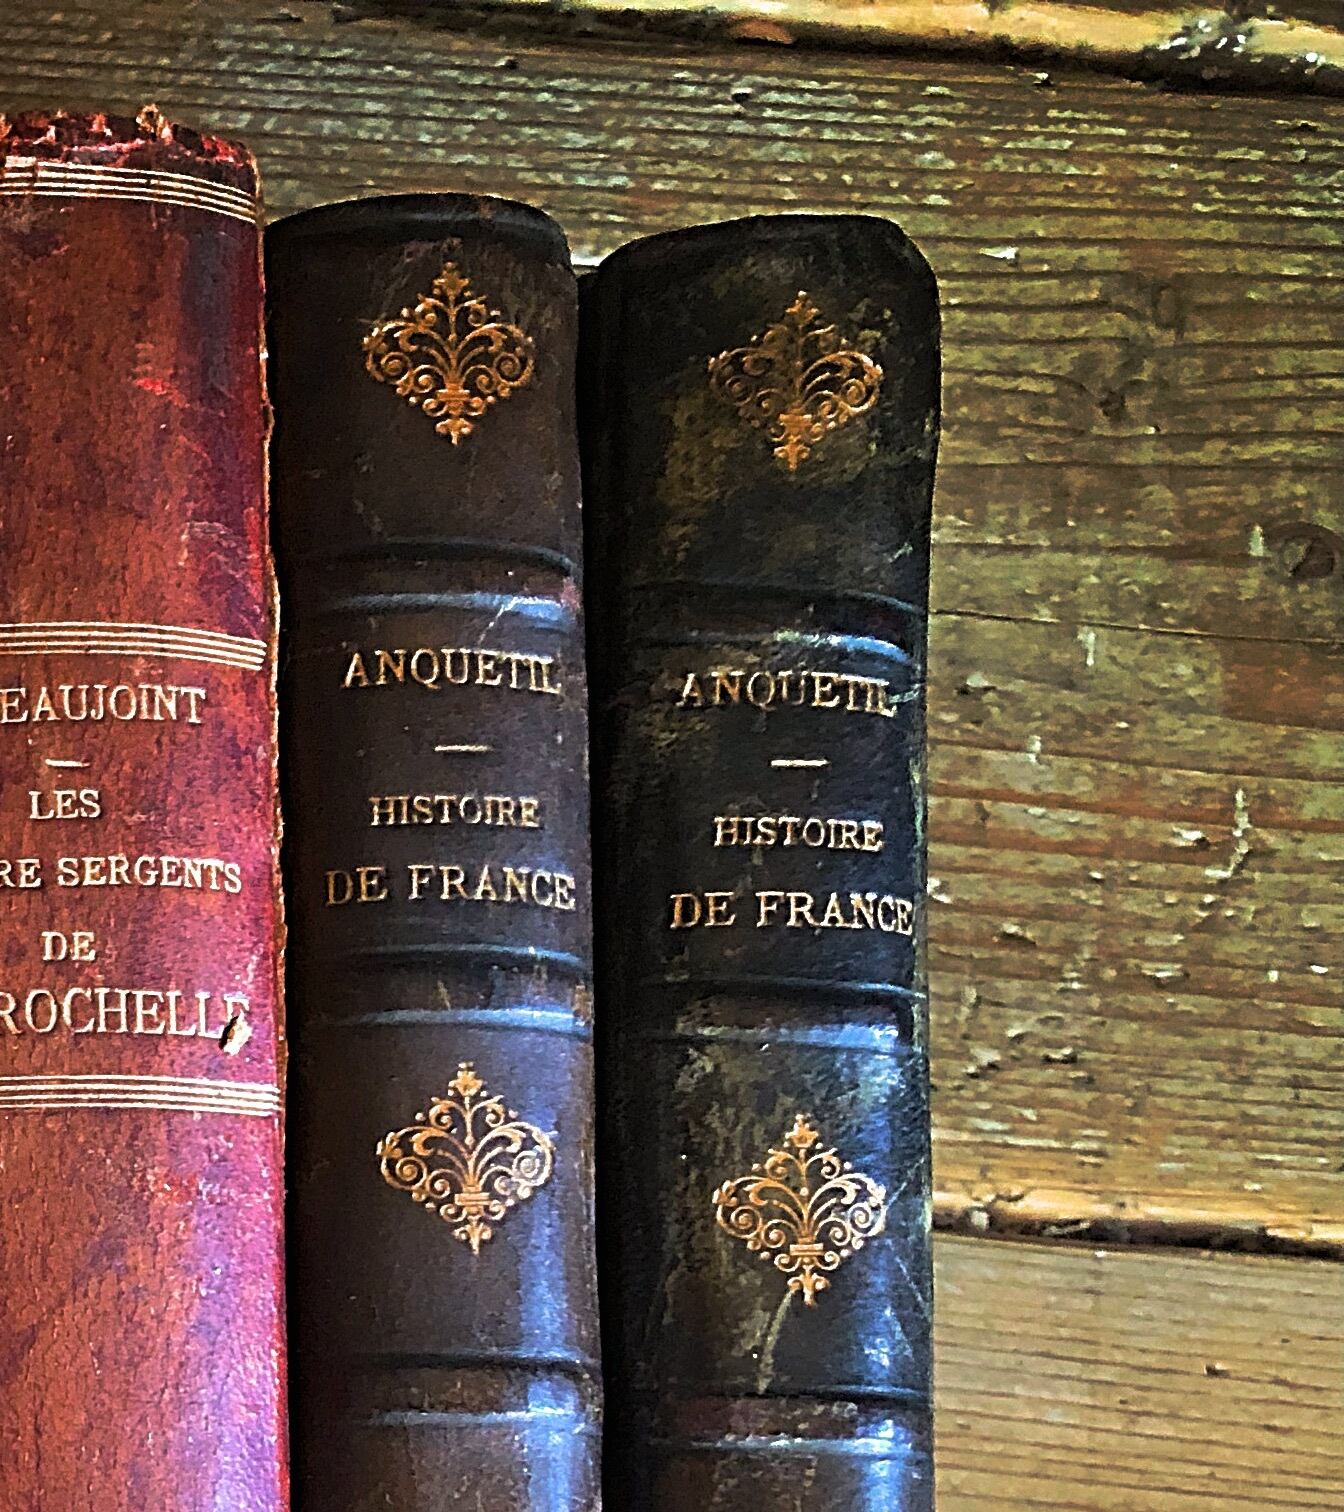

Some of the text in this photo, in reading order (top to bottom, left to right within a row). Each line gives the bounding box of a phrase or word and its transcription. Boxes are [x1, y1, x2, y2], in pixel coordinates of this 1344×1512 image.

[340, 647, 562, 695] ANQUETIL
[676, 670, 897, 718] ANQUETIL
[28, 789, 102, 821] LES
[368, 794, 543, 829] HISTOIRE
[714, 816, 885, 852] HISTOIRE
[57, 855, 243, 894] SERGENTS
[324, 863, 576, 911] DE FRANCE
[669, 890, 912, 936] DE FRANCE
[41, 931, 97, 963] DE
